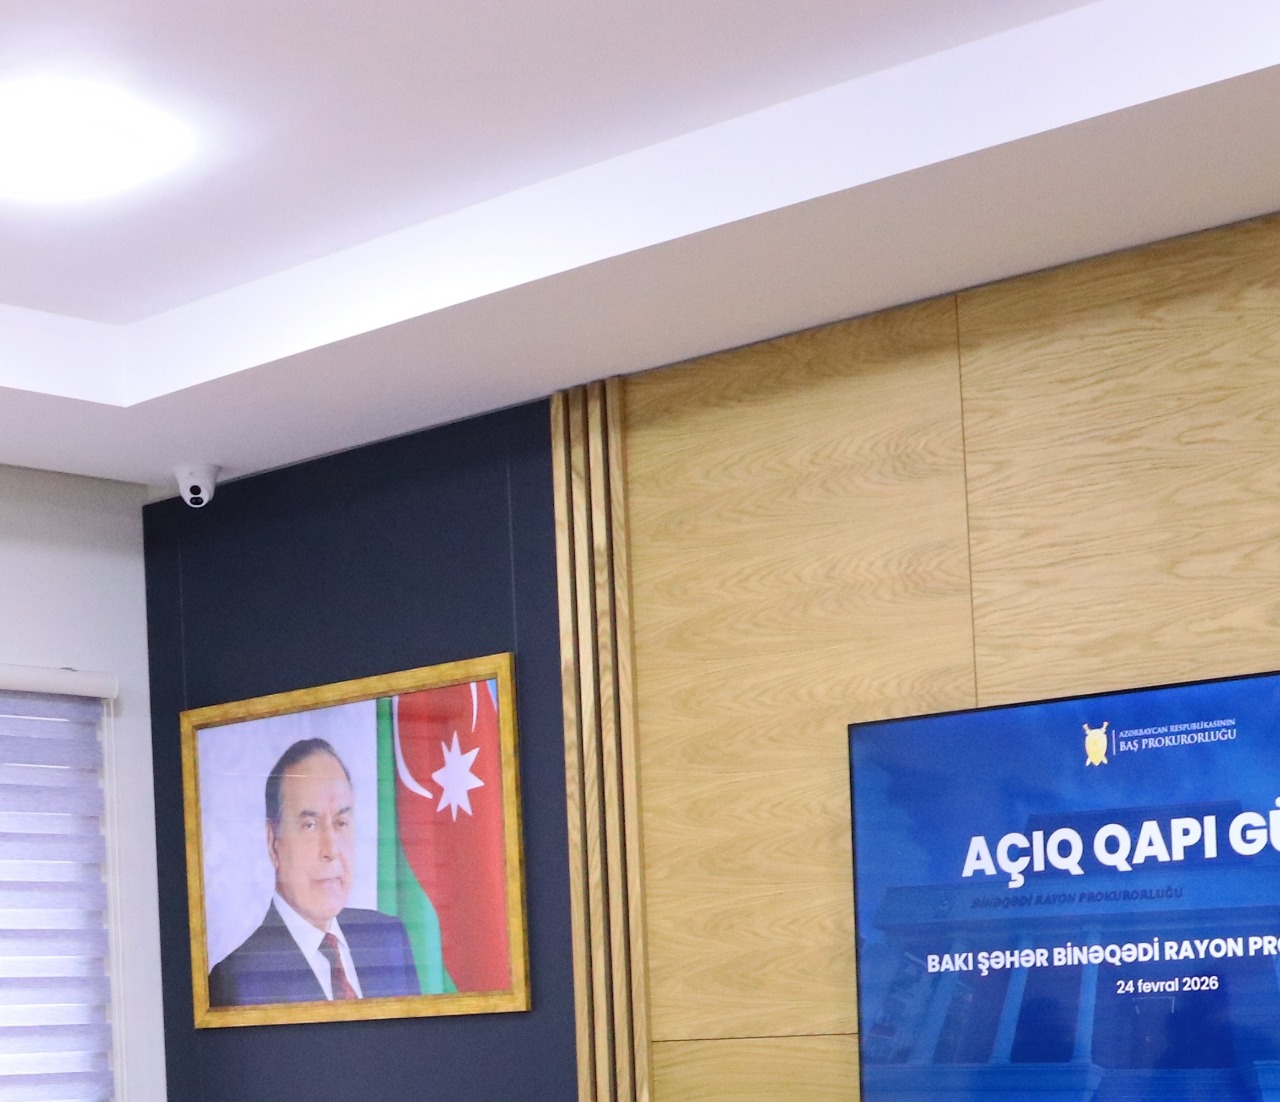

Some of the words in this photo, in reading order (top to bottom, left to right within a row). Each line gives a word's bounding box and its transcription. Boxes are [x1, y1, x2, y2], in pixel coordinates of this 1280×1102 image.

[1119, 726, 1168, 738] AZƏRBAYCAN
[1119, 739, 1139, 752] BAŞ
[1142, 728, 1237, 750] PROKURORLUĞU
[961, 827, 1085, 888] AÇIQ
[1093, 815, 1218, 872] QAPI
[1228, 797, 1280, 856] G
[1036, 892, 1077, 906] RAYON
[1079, 887, 1183, 903] PROKURORLUĞU
[927, 952, 974, 973] BAKI
[977, 948, 1049, 977] ŞƏHƏR
[1053, 937, 1160, 966] BİNƏQƏDİ
[1164, 937, 1244, 961] RAYON
[1248, 935, 1280, 957] PR
[1116, 980, 1135, 994] 24
[1137, 977, 1179, 993] fevral
[1182, 976, 1219, 991] 2026
